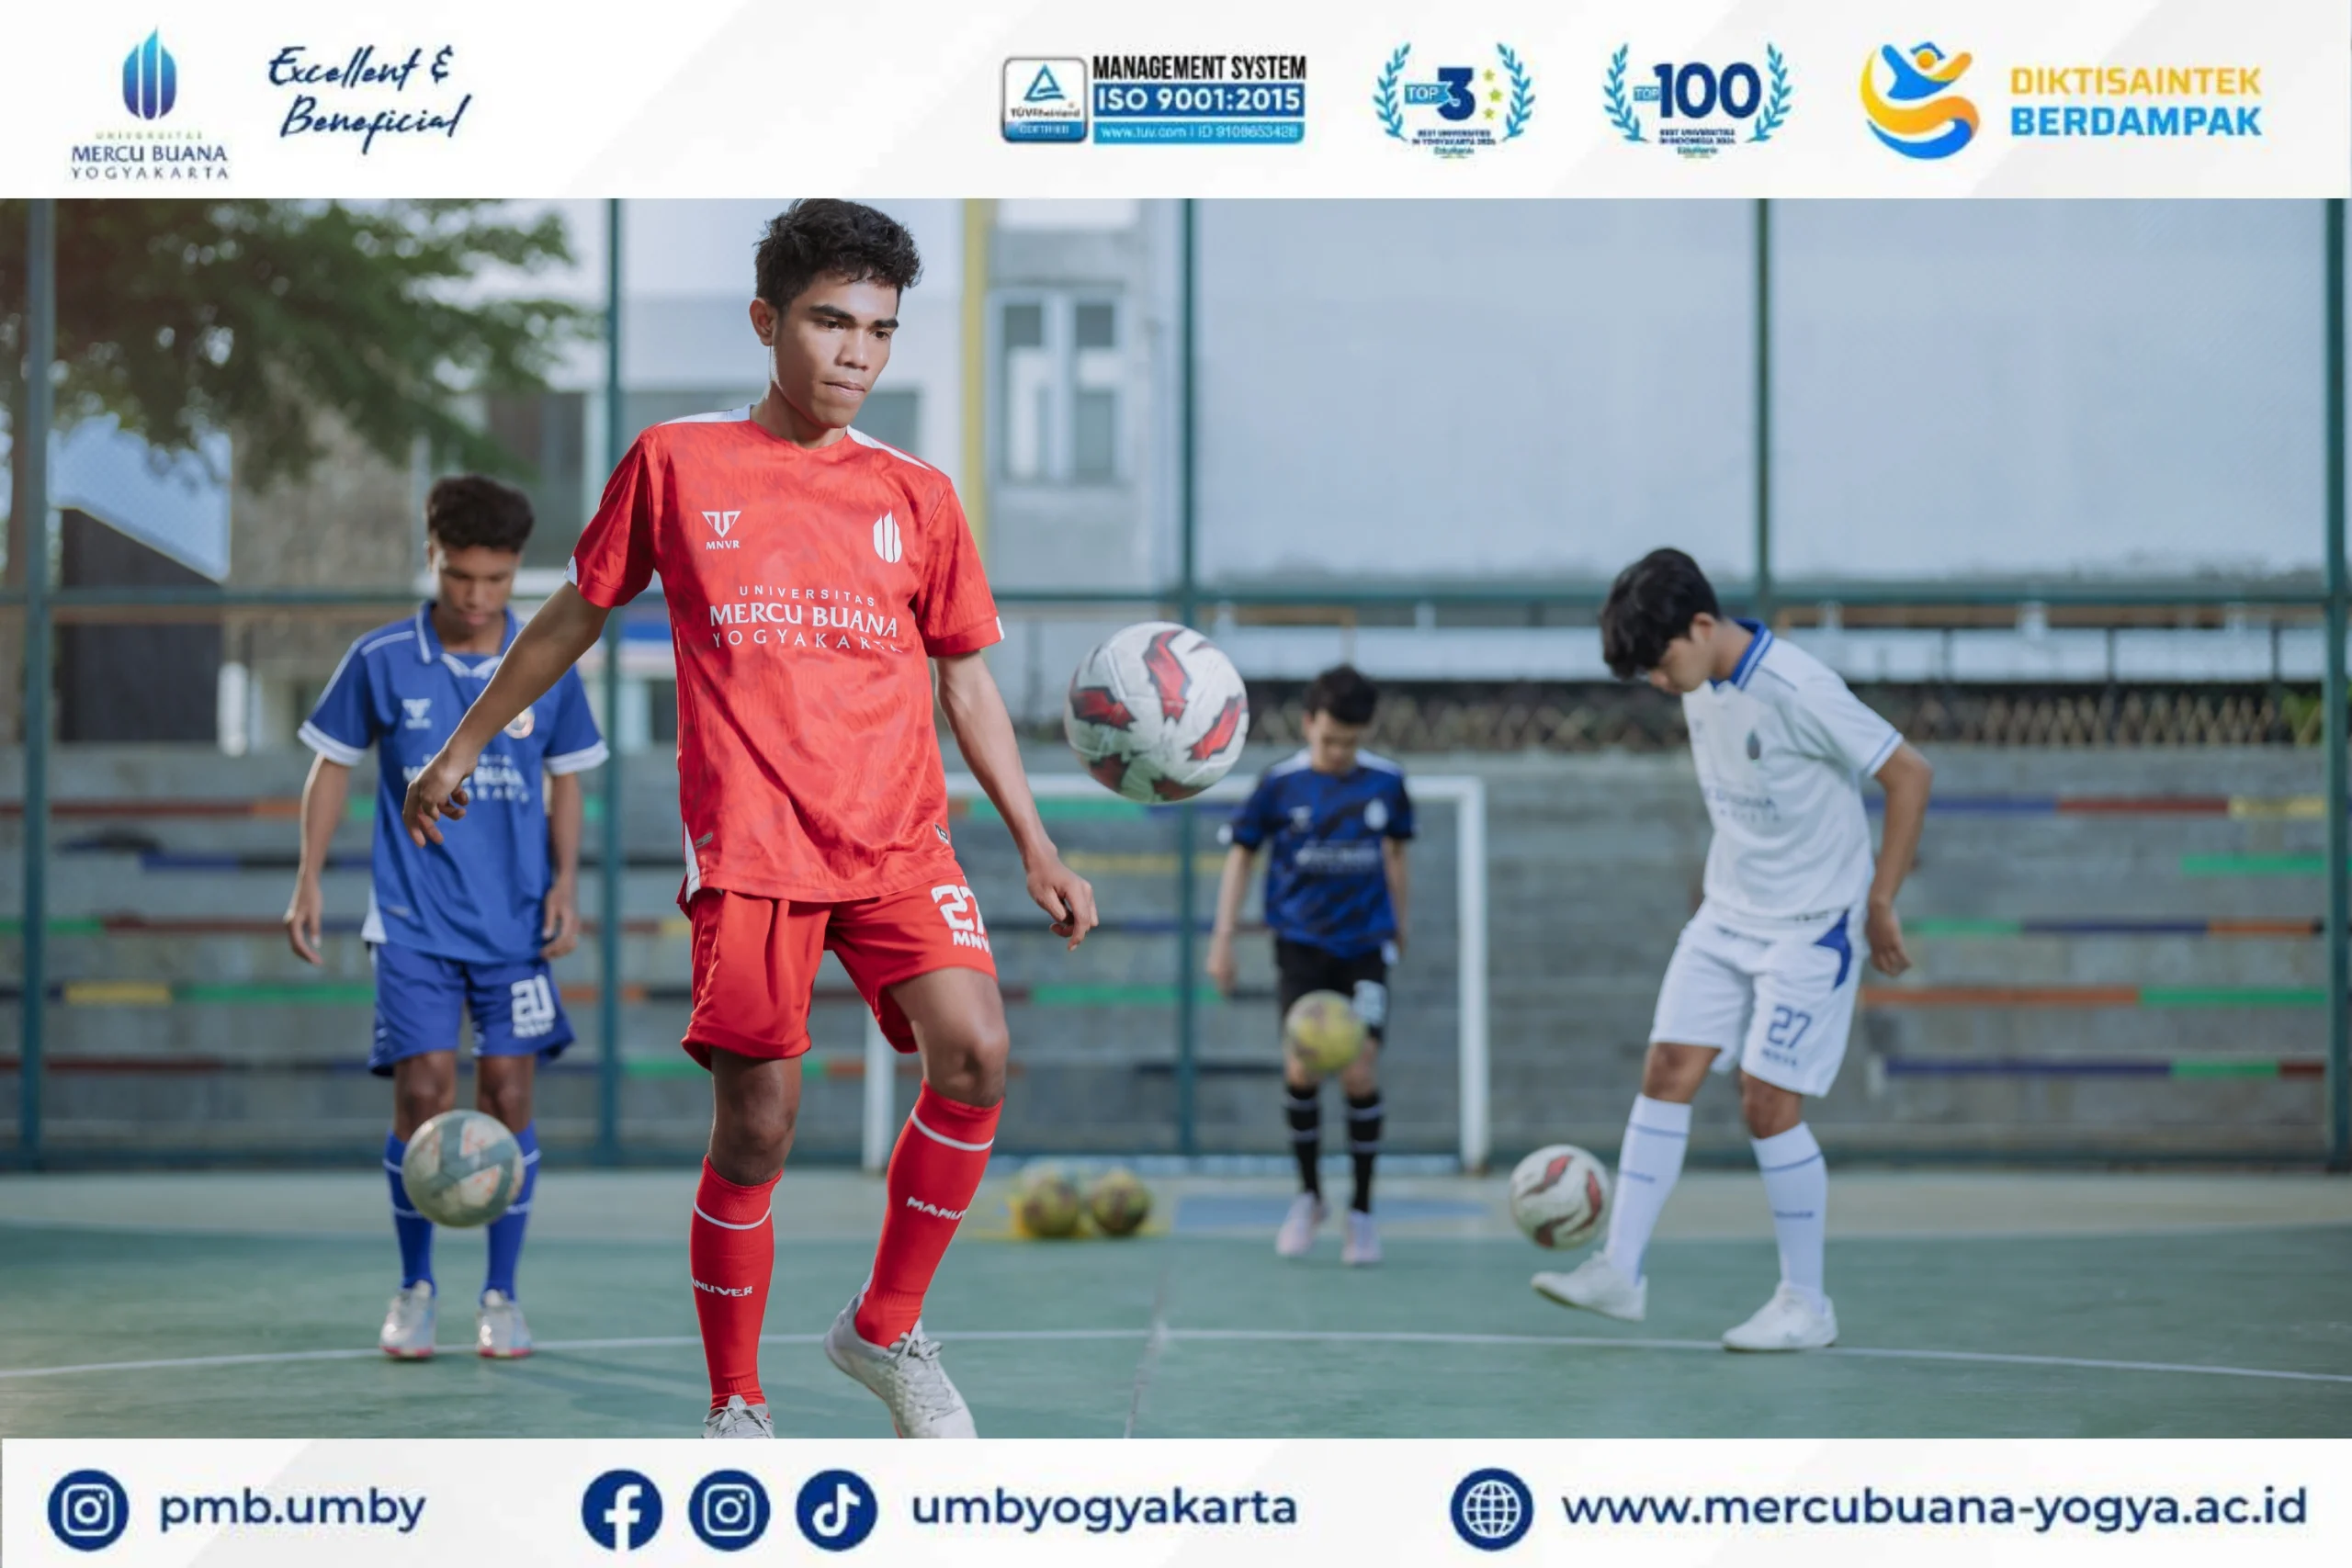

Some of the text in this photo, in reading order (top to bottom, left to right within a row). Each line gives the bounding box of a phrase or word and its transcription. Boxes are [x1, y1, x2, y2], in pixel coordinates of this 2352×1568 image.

[706, 540, 741, 551] MNVR
[739, 584, 876, 607] UNIVERSITAS
[709, 603, 898, 638] MERCU BUANA
[931, 885, 985, 935] 27
[953, 931, 993, 957] MNV
[1767, 1004, 1813, 1049] 27
